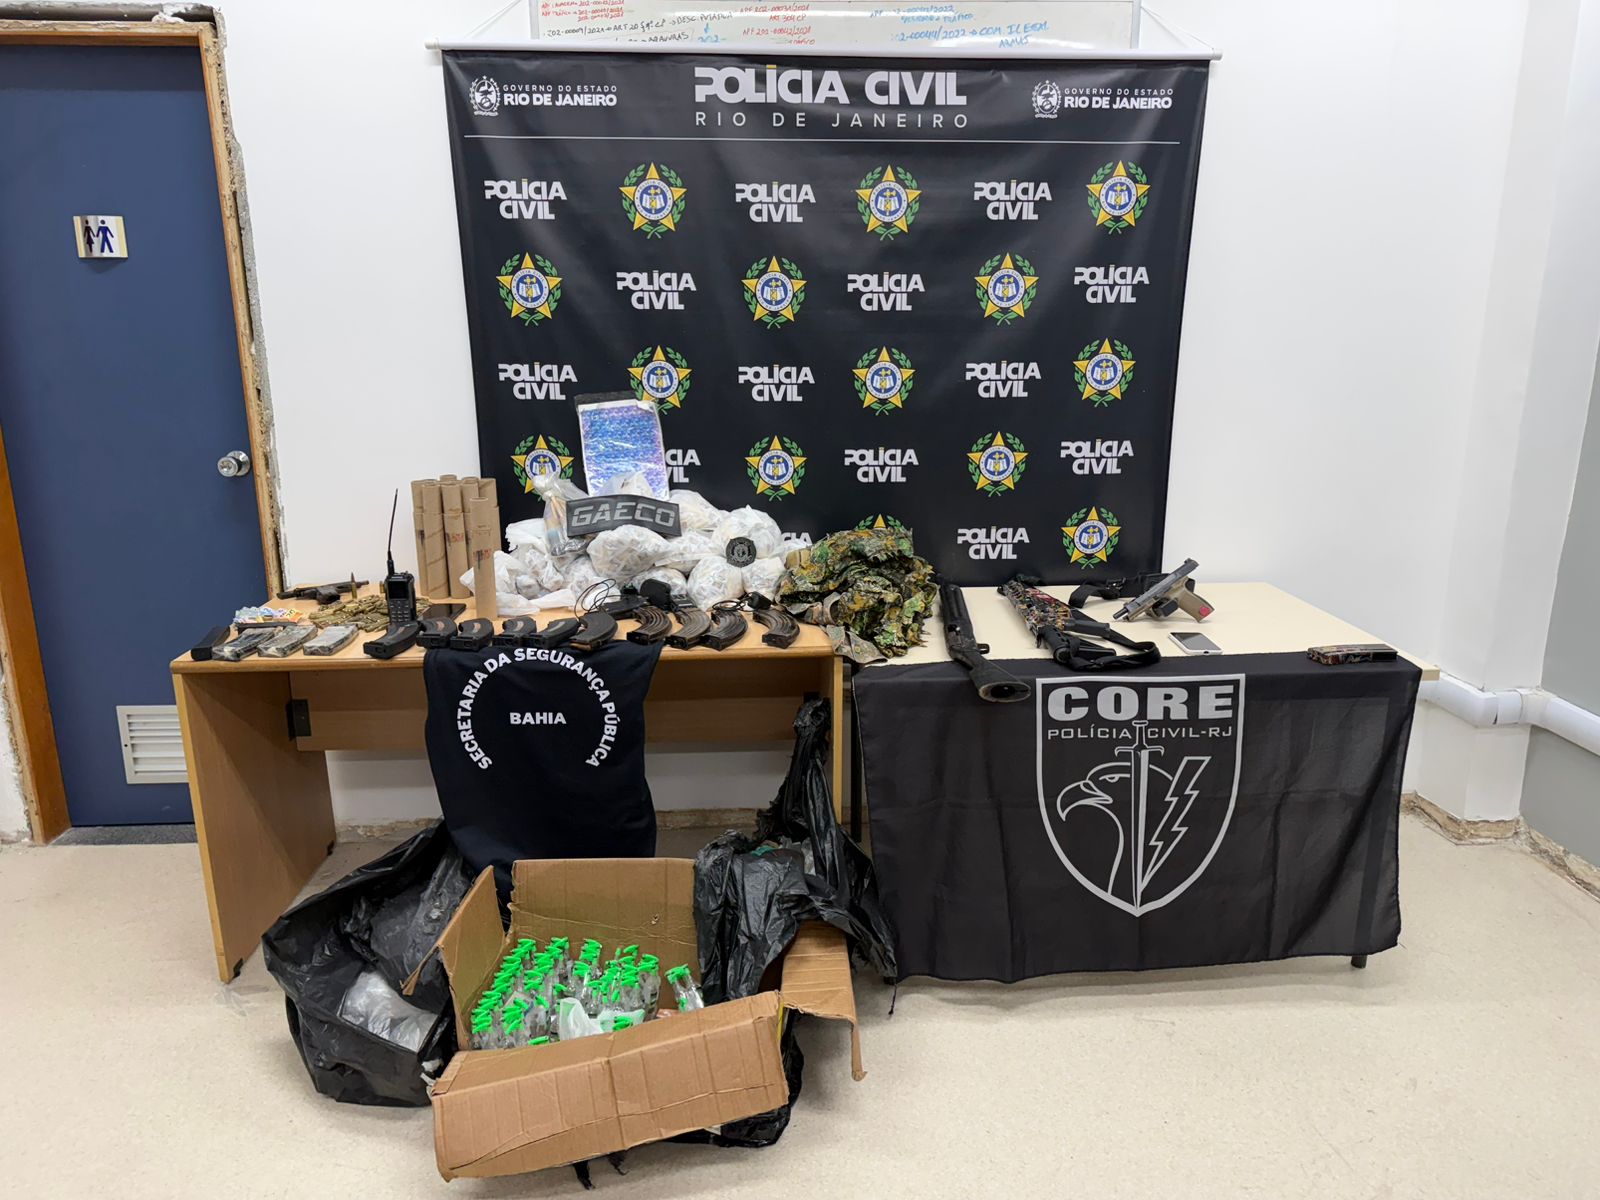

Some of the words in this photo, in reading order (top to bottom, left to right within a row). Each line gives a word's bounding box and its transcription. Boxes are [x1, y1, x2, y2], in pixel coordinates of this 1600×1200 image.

[502, 84, 553, 92] GOVERNO
[864, 70, 968, 106] CIVIL
[1063, 87, 1113, 96] GOVERNO
[1134, 88, 1174, 96] ESTADO
[503, 92, 531, 106] RIO
[532, 93, 553, 106] DE
[554, 93, 618, 107] JANEIRO
[1063, 96, 1090, 109] RIO
[1091, 97, 1111, 109] DE
[1112, 96, 1173, 109] JANEIRO
[695, 111, 747, 127] RIO
[772, 112, 806, 127] DE
[831, 112, 968, 129] JANEIRO
[499, 200, 556, 220] CIVIL
[749, 203, 804, 223] CIVIL
[986, 201, 1039, 221] CIVIL
[630, 291, 685, 310] CIVIL
[860, 292, 913, 312] CIVIL
[1085, 285, 1137, 304] CIVIL
[512, 383, 566, 401] CIVIL
[751, 384, 803, 402] CIVIL
[977, 380, 1029, 399] CIVIL
[856, 466, 907, 483] CIVIL
[1072, 457, 1122, 475] CIVIL
[571, 501, 676, 527] GAECO
[968, 543, 1018, 560] CIVIL
[456, 670, 493, 770] SECRETARIA
[483, 652, 512, 674] DA
[513, 647, 611, 703] SEGURANÇA
[585, 701, 621, 768] PÚBLICA
[1047, 685, 1234, 722] CORE
[509, 712, 567, 725] BAHIA
[1047, 723, 1133, 740] POLÍCIA
[1147, 726, 1232, 739] CIVIL-RJ
